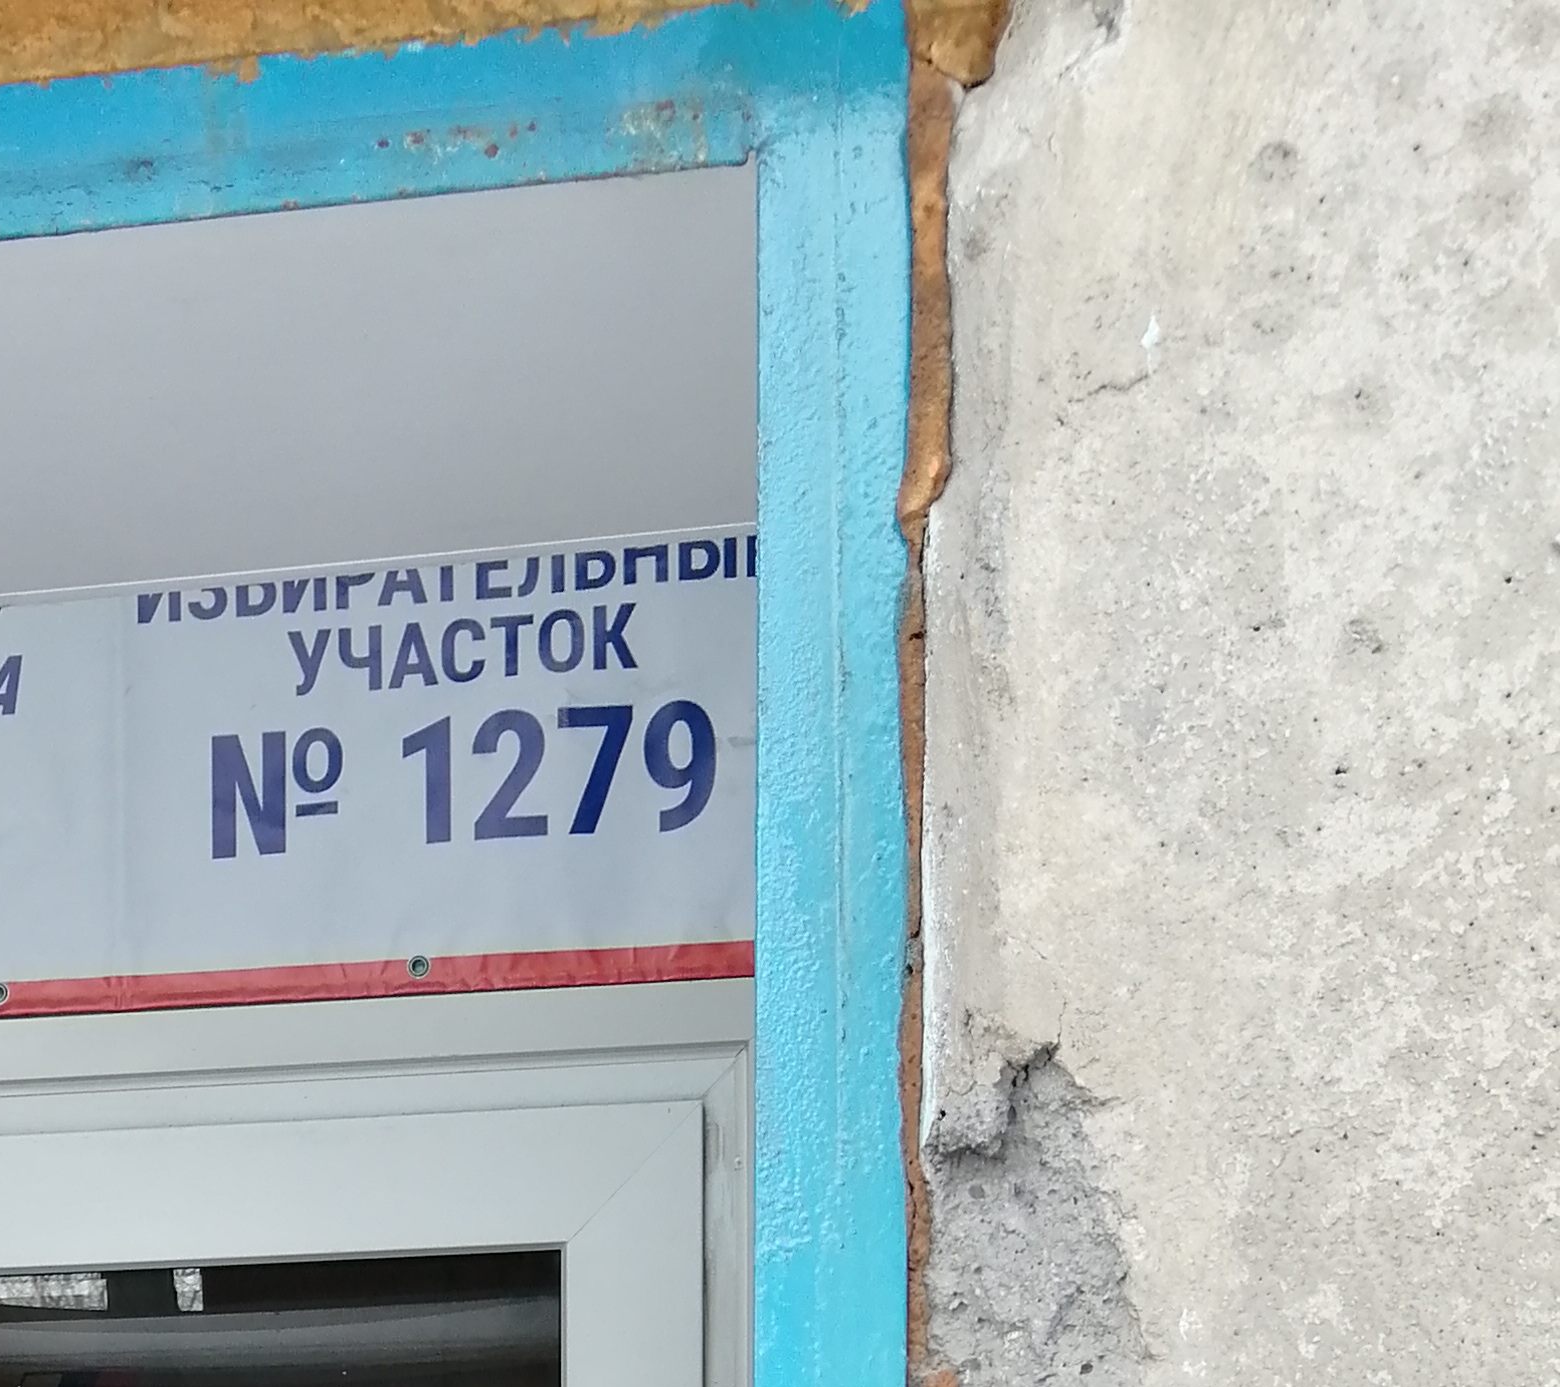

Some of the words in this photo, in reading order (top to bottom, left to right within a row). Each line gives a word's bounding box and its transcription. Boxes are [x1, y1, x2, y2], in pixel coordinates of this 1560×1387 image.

[137, 535, 757, 624] ИЗБИРАТЕЛЬНЫ
[287, 603, 638, 696] УЧАСТОК
[210, 727, 344, 860] №
[401, 700, 717, 844] 1279
